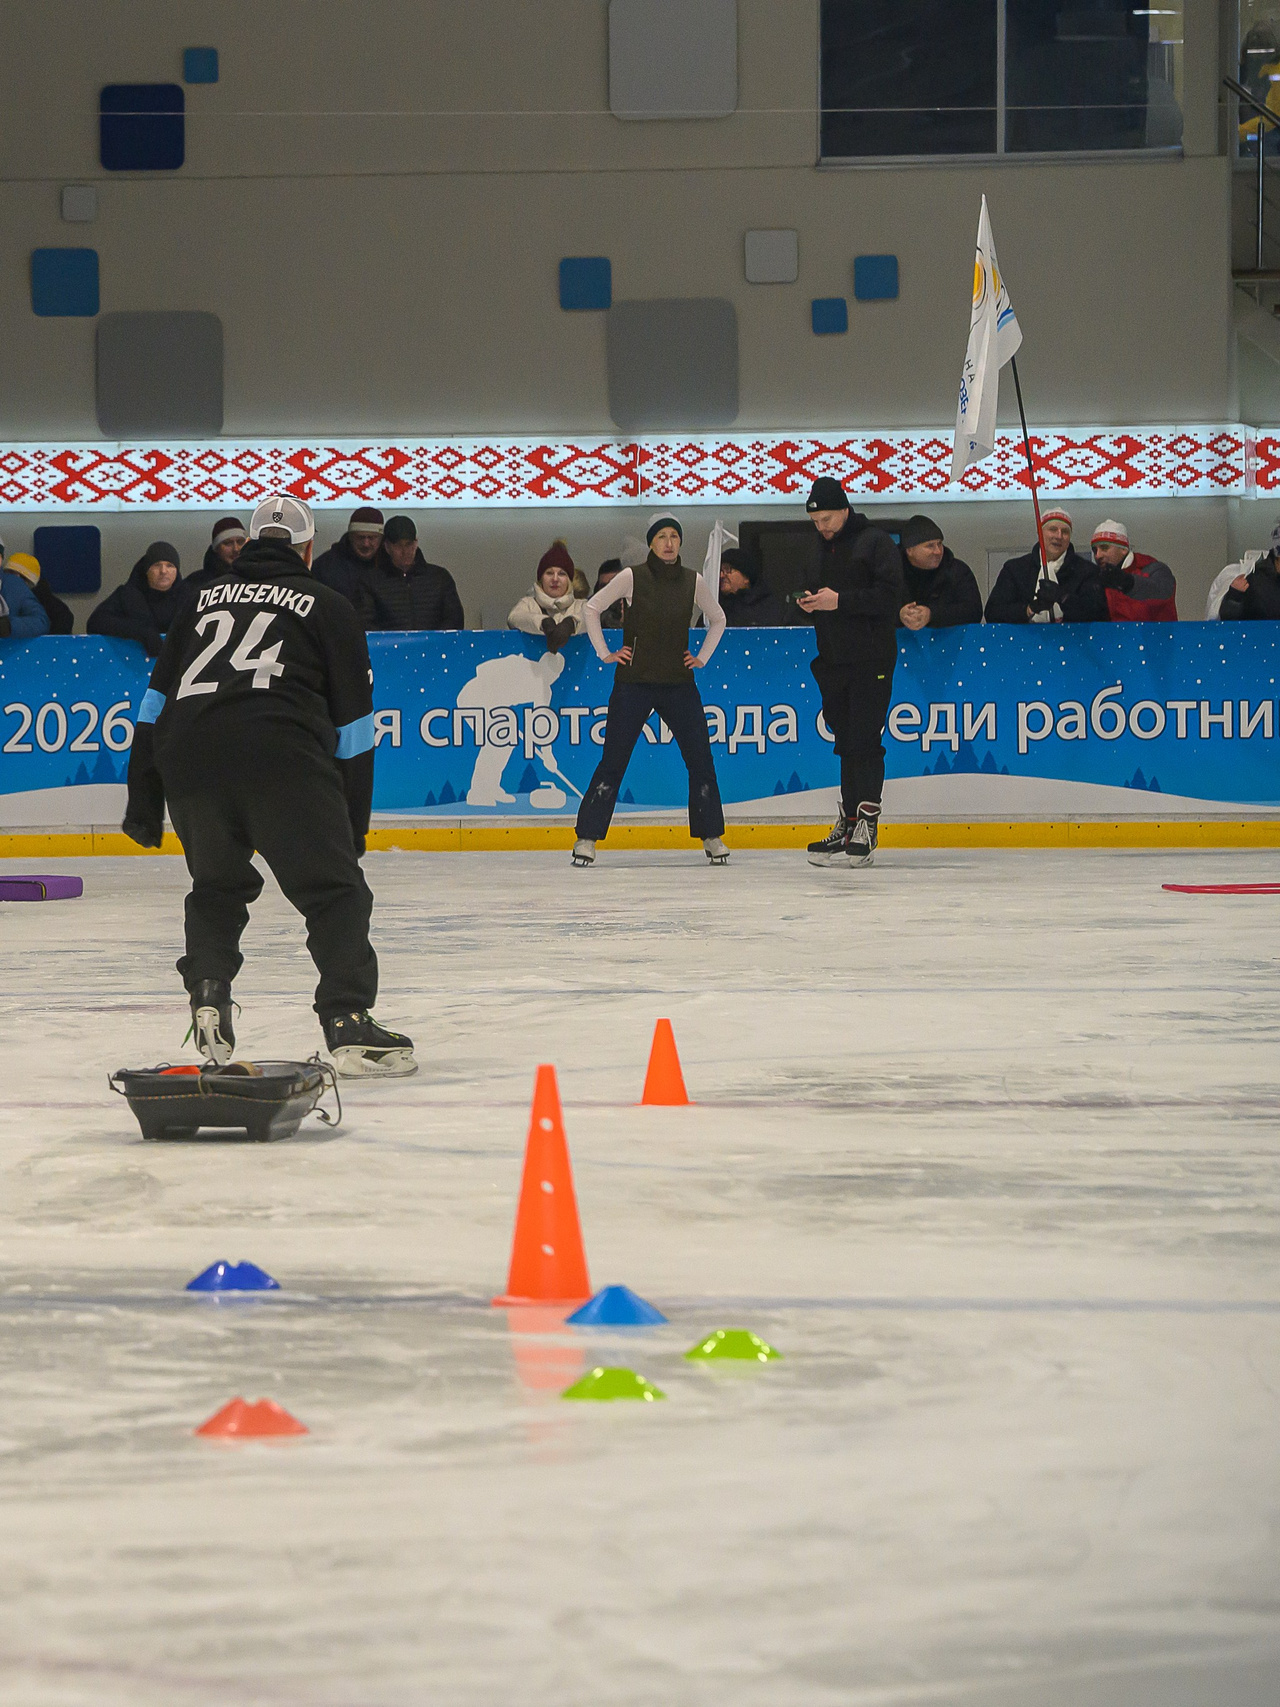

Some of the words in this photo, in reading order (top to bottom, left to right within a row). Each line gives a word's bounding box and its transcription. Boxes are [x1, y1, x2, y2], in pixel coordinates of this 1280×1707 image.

[197, 584, 315, 618] DENISENKO
[176, 610, 285, 701] 24
[2, 699, 136, 753] 2026
[419, 704, 798, 760] спартаада
[815, 702, 996, 752] седи
[1017, 684, 1280, 755] работни
